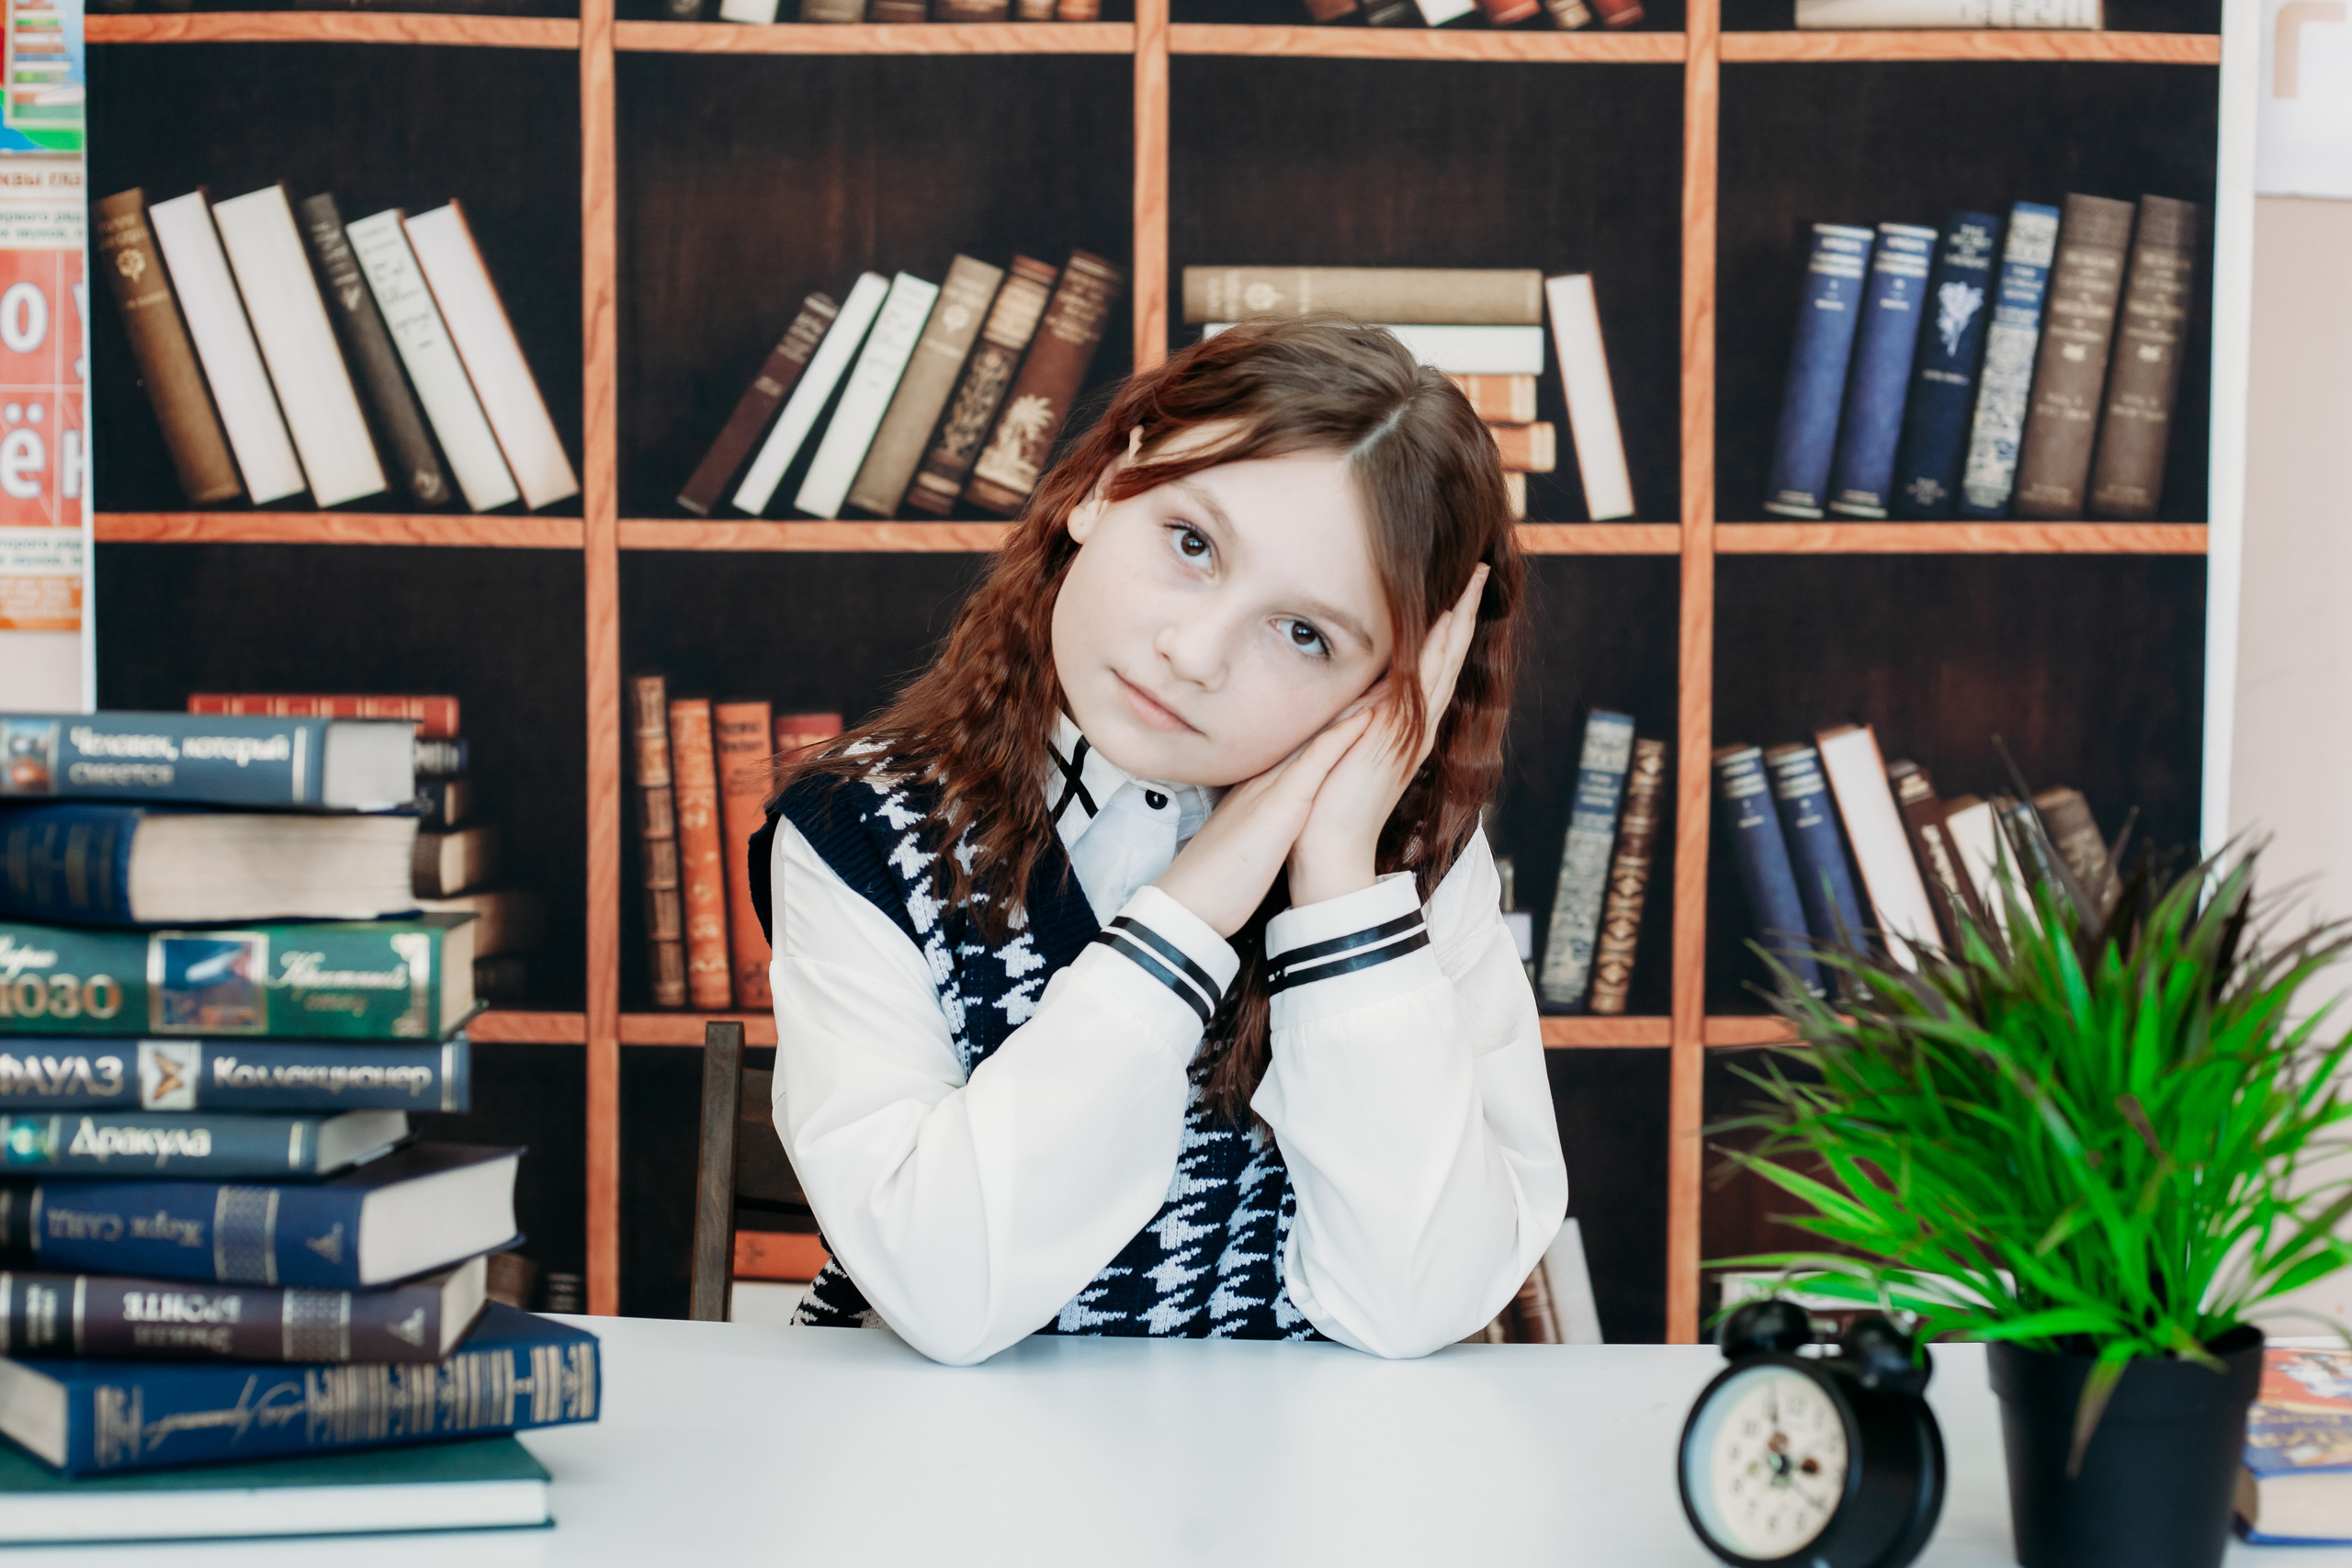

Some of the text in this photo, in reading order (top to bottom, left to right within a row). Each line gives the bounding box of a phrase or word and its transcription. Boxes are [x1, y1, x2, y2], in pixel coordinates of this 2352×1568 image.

[70, 726, 289, 768] Человек, который
[213, 1056, 433, 1098] Коллекционер
[69, 1116, 211, 1168] Дракула
